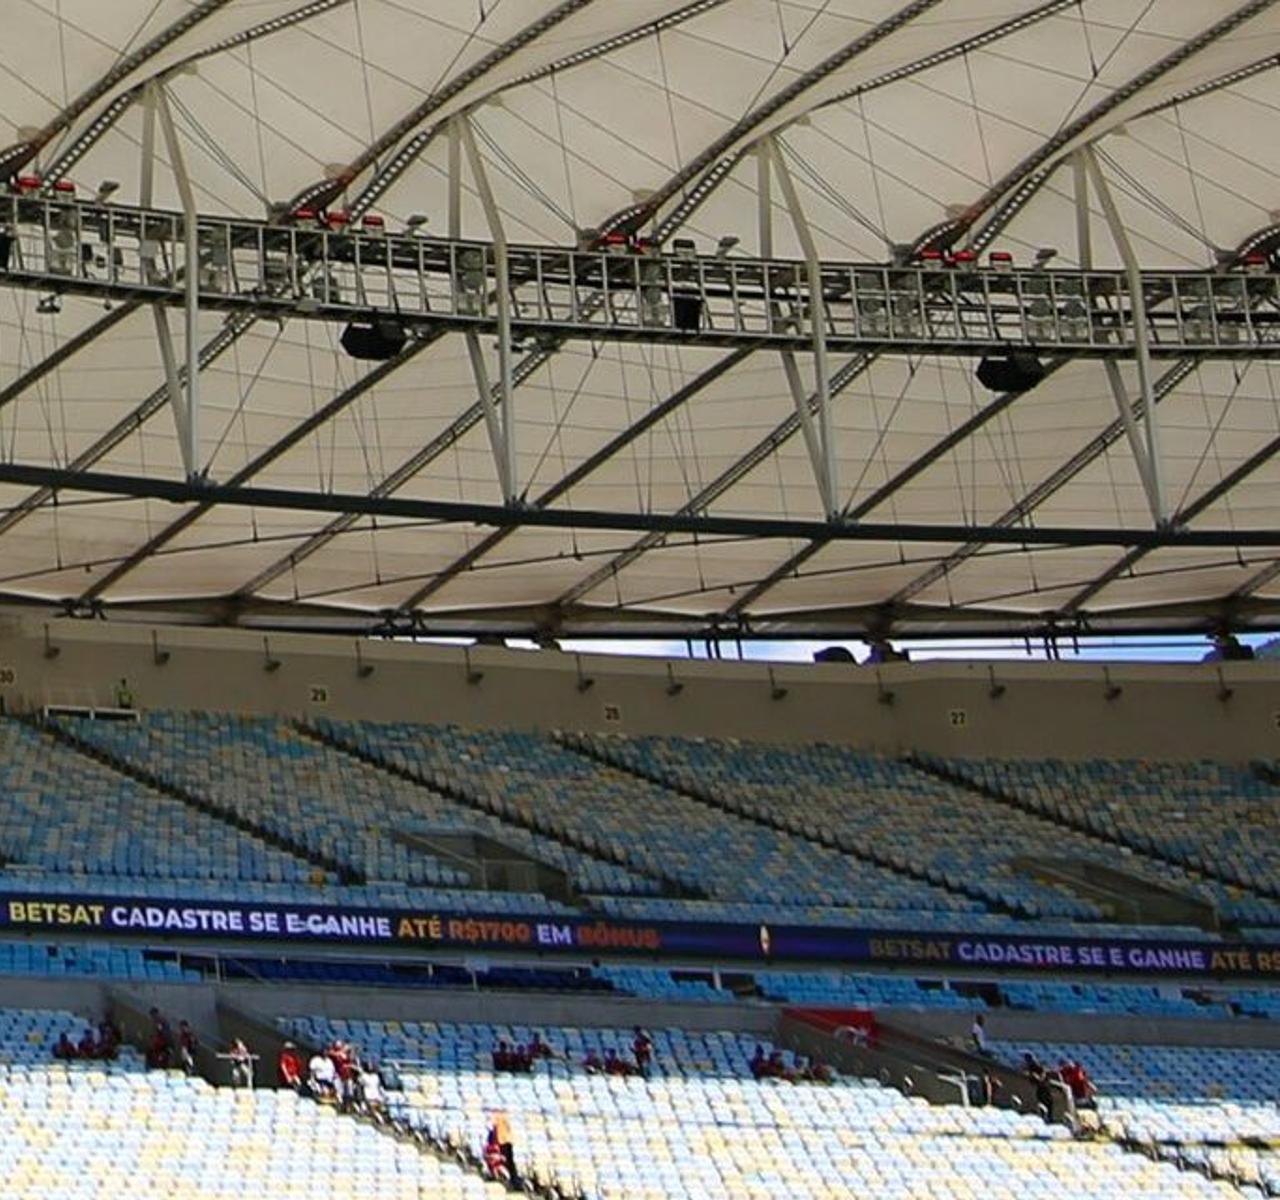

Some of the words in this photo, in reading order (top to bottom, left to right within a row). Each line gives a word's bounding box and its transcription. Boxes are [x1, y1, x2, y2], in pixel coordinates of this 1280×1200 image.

[9, 902, 105, 925] BETSAT
[111, 906, 244, 931] CADASTRE
[249, 911, 280, 933] SE
[307, 914, 392, 937] GANHE
[398, 915, 443, 939] ATÉ
[449, 919, 530, 942] R$1700
[537, 924, 573, 945] EM
[869, 938, 951, 960] BETSAT
[958, 942, 1074, 964] CADASTRE
[1078, 946, 1105, 966] SE
[1109, 947, 1125, 966] E
[1128, 948, 1206, 969] GANHE
